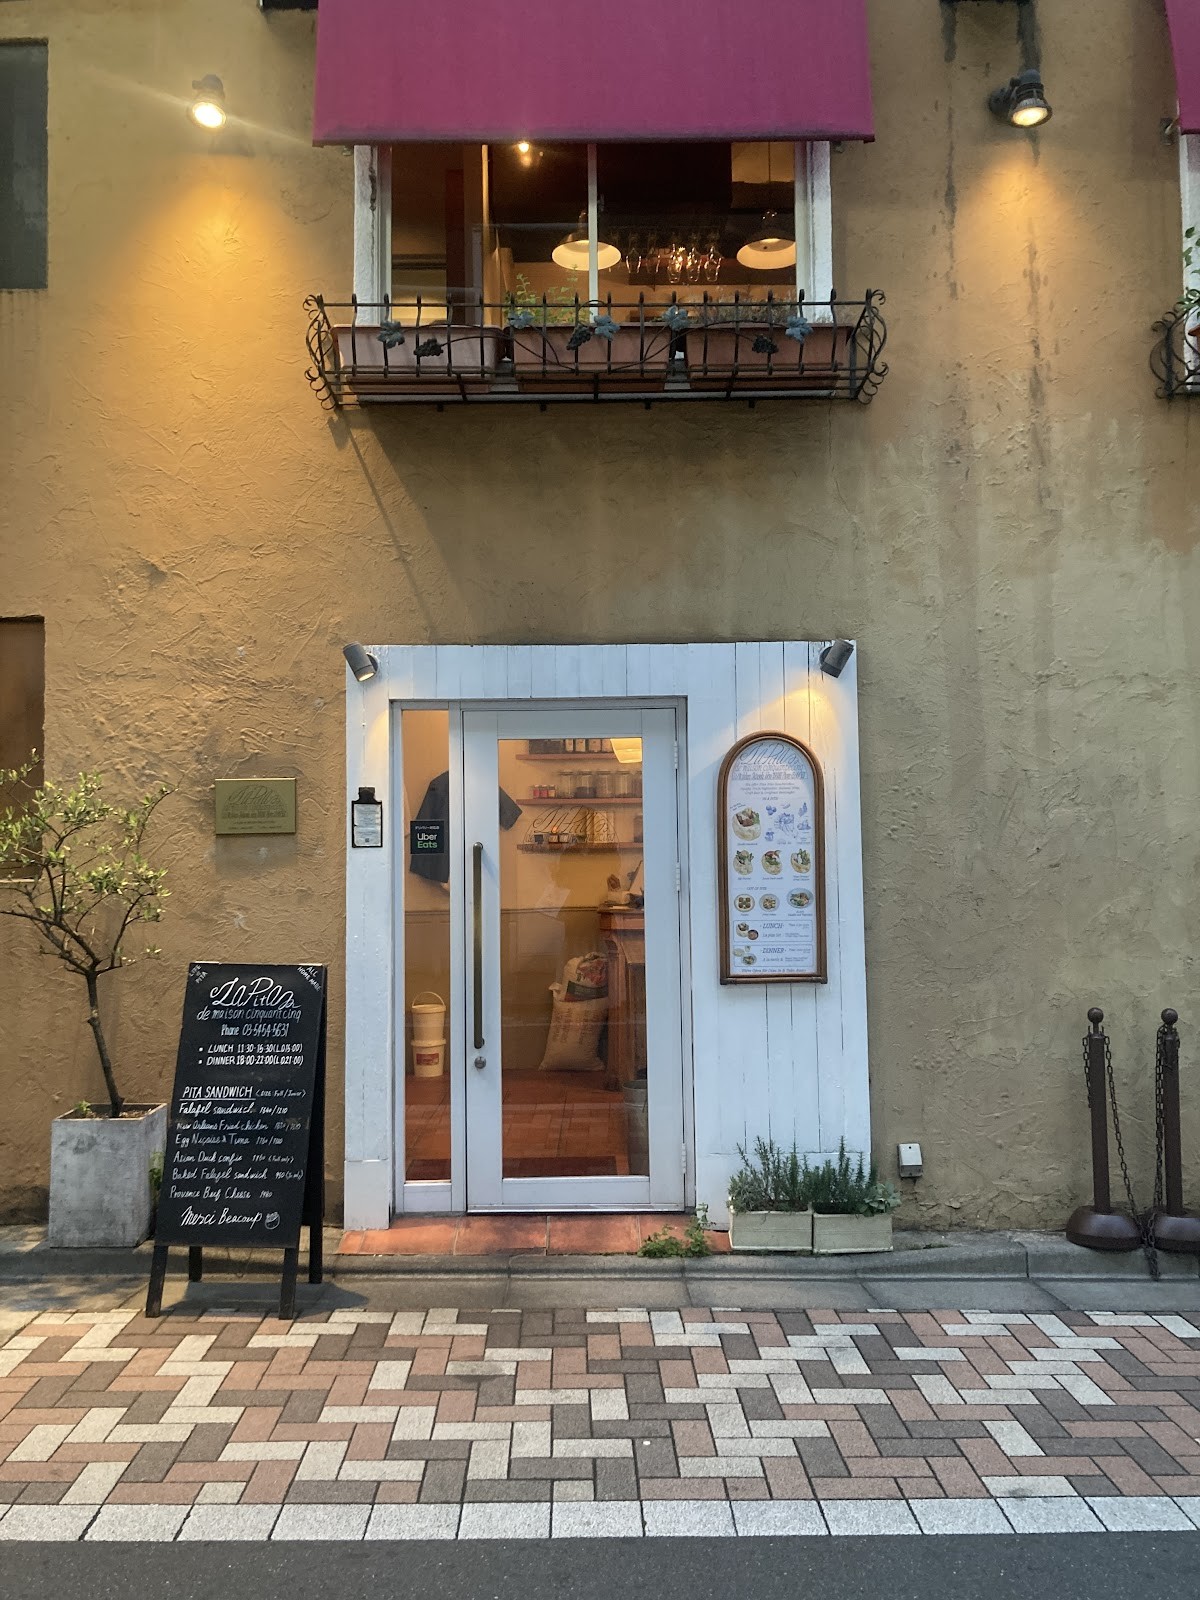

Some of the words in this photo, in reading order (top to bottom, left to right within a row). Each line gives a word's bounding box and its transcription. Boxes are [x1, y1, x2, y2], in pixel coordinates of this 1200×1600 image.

[417, 832, 438, 841] Uber
[417, 840, 438, 849] Eats
[196, 1005, 211, 1021] de
[211, 1008, 245, 1020] maison
[221, 1023, 240, 1036] Phone
[207, 1043, 235, 1054] LUNCH
[206, 1055, 237, 1066] DINNER
[182, 1086, 203, 1098] PITA
[204, 1085, 254, 1098] SANDWICH
[179, 1101, 212, 1117] Falafel
[213, 1101, 255, 1115] sandwich
[218, 1119, 241, 1130] Fried
[240, 1119, 269, 1131] chicken
[175, 1133, 191, 1148] Egg
[228, 1132, 250, 1145] Tuna
[173, 1150, 196, 1163] Asian
[197, 1150, 218, 1163] Duck
[172, 1167, 198, 1180] Baked
[233, 1167, 269, 1180] sandwich
[224, 1186, 252, 1199] Cheese
[180, 1205, 217, 1227] Merci
